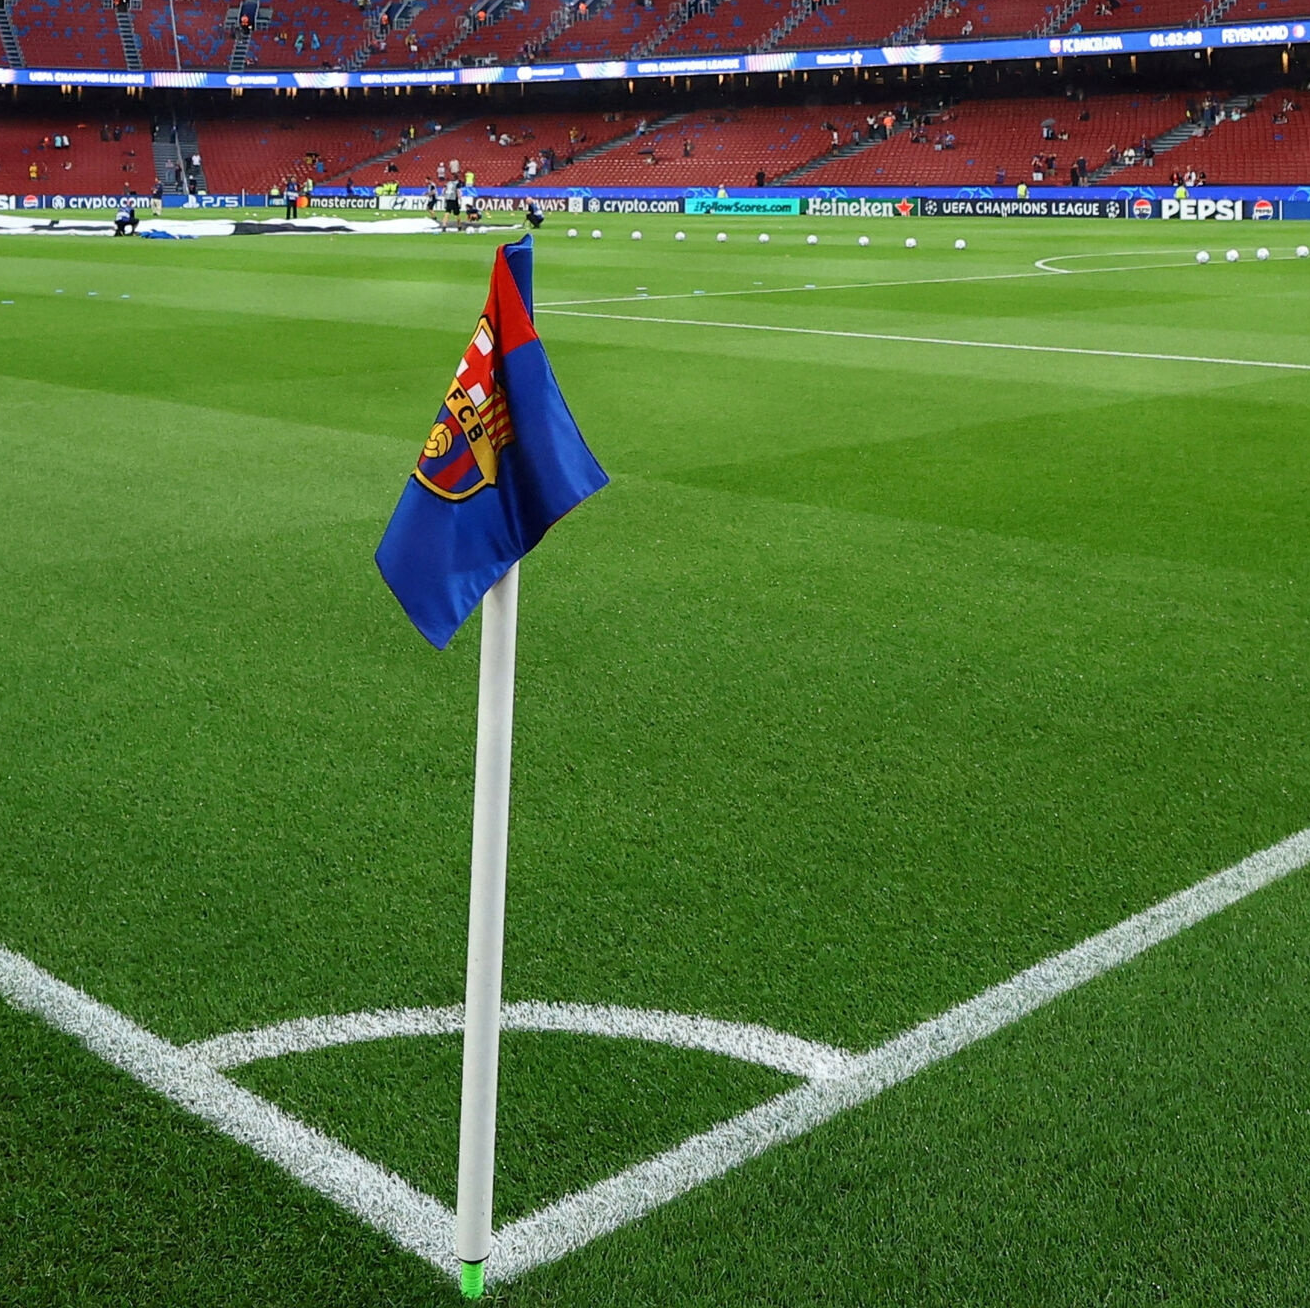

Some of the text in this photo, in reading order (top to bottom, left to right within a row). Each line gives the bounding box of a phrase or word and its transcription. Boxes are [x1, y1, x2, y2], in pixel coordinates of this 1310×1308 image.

[1222, 25, 1288, 45] FEYENOORD
[1062, 35, 1123, 53] FC BARCELONA
[68, 196, 151, 210] crypto.com
[201, 196, 239, 208] PS5
[310, 196, 377, 208] mastercard
[475, 198, 513, 212] QATAR
[603, 198, 679, 213] crypto.com
[808, 198, 894, 216] Heineken
[943, 202, 1100, 216] UEFA CHAMPIONS LEAGUE
[1161, 199, 1243, 220] PEPSI
[445, 386, 484, 444] FCB
